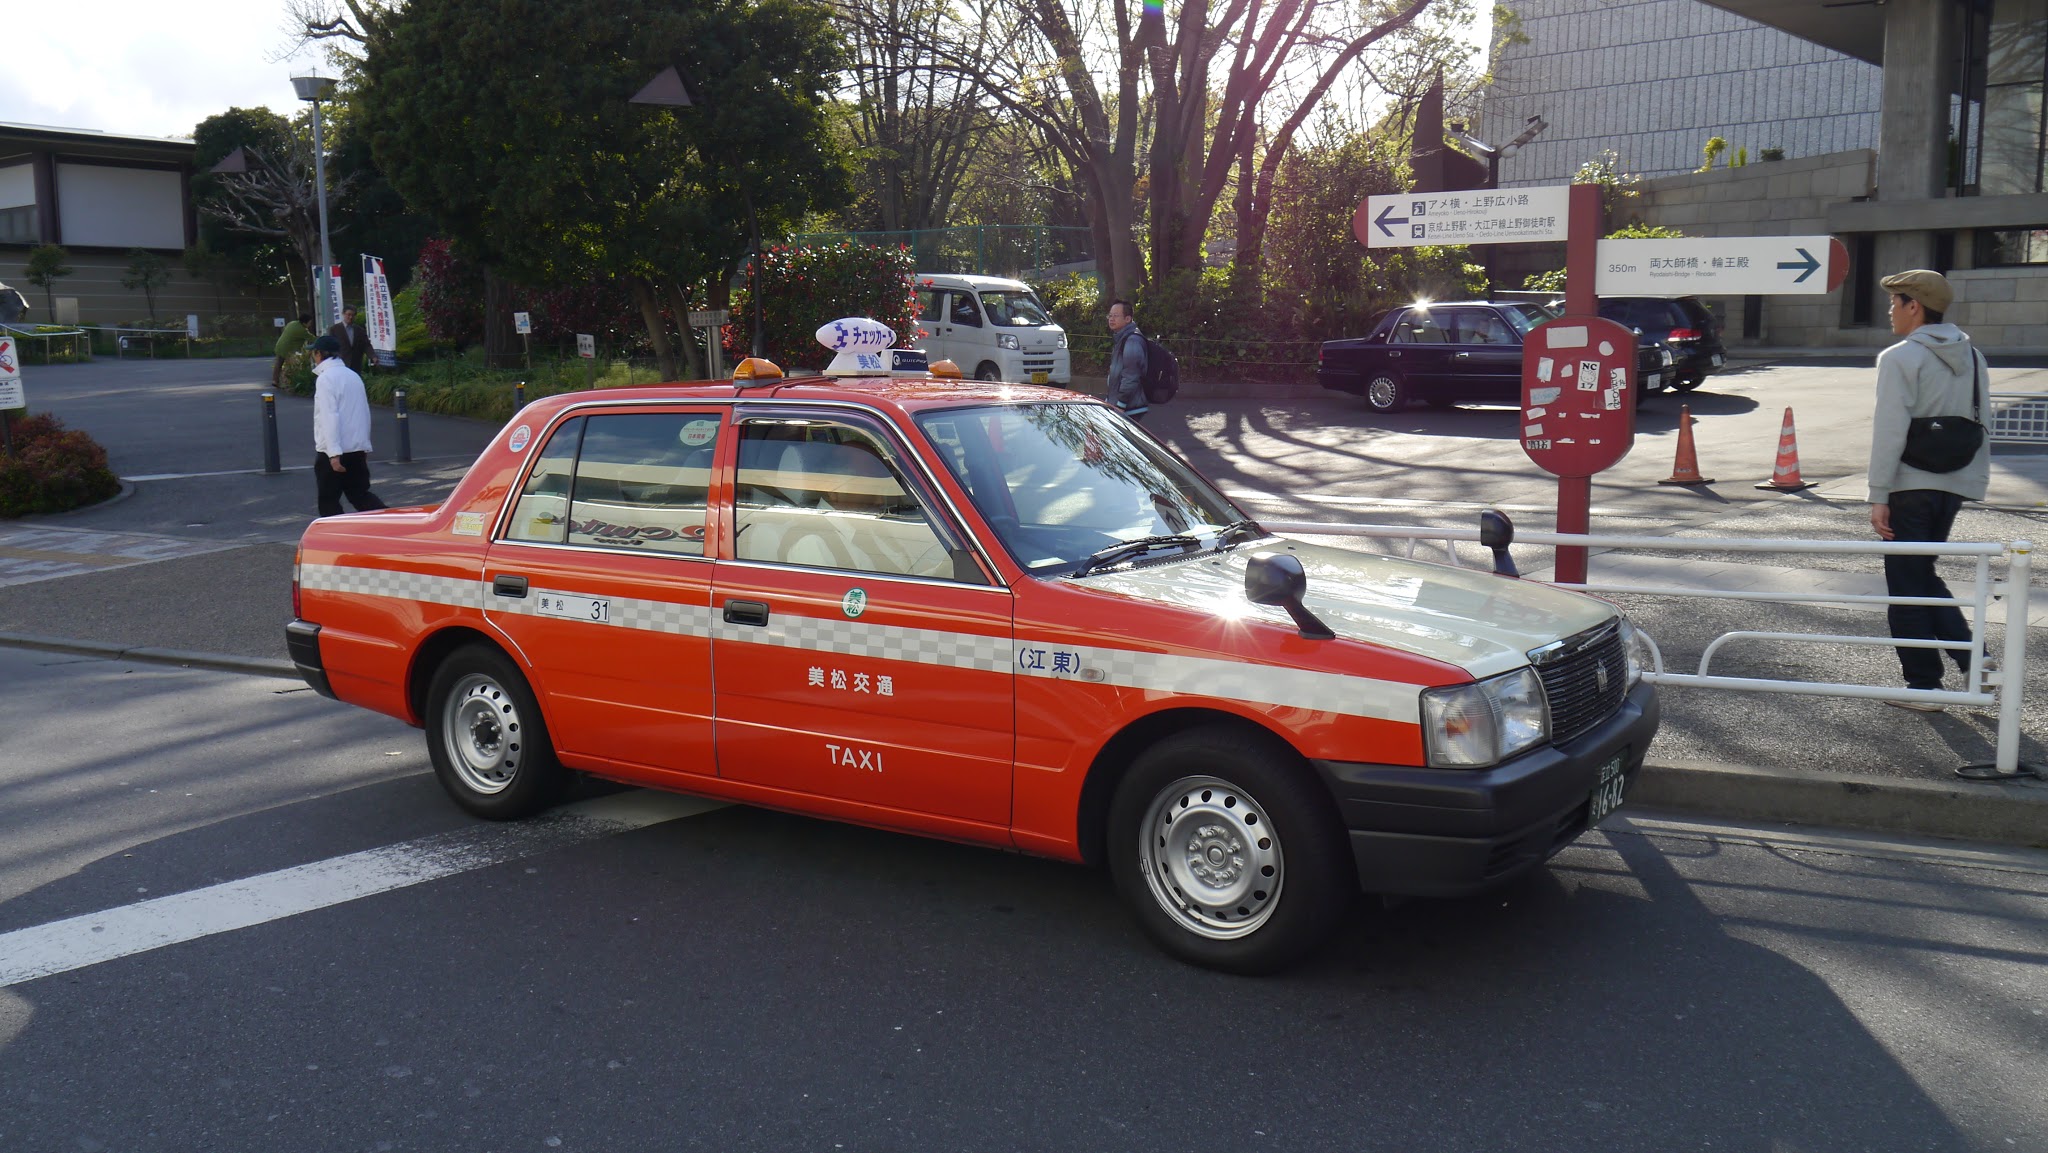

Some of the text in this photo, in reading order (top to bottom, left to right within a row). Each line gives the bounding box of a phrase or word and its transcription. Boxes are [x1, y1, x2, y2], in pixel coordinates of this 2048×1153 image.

[1428, 195, 1529, 209] アメ横・上野広小路
[1428, 216, 1556, 232] 京成上野駅・大江戸線上野御徒町駅
[1608, 264, 1637, 272] 350m
[1649, 256, 1750, 269] 両大師橋・輪王殿
[857, 354, 882, 369] 美松
[1582, 362, 1597, 371] NC
[1580, 382, 1594, 390] 17
[541, 598, 564, 611] 美松
[846, 590, 863, 615] 美松
[590, 601, 608, 620] 31
[808, 666, 894, 697] 美松交通
[826, 743, 883, 773] TAXI
[1597, 773, 1625, 820] 16-82
